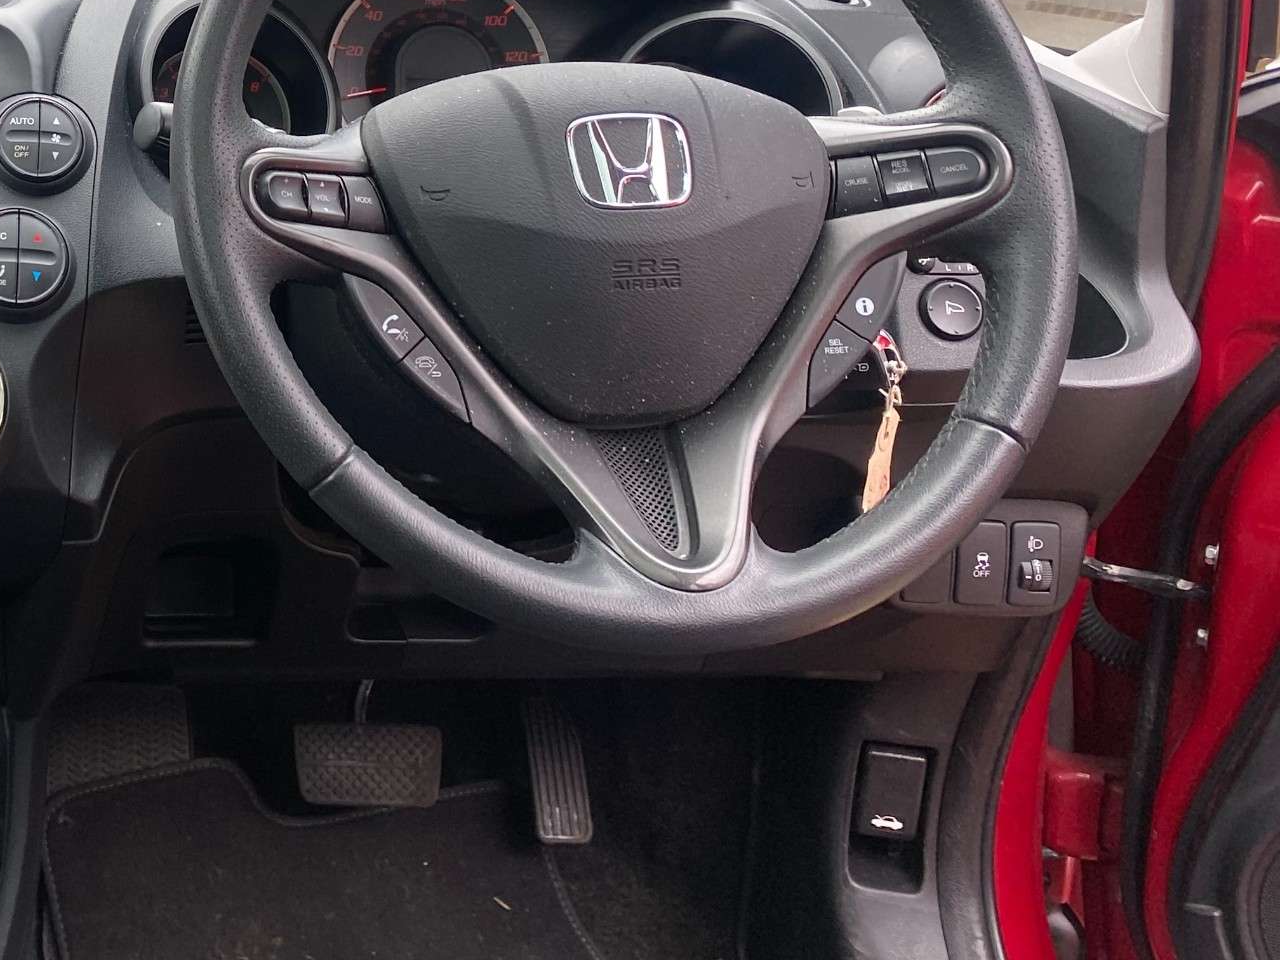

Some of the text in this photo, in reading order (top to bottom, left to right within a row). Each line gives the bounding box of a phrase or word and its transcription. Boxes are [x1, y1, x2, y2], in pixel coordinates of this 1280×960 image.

[366, 10, 384, 22] 40
[484, 15, 508, 27] 100
[346, 46, 364, 57] 20
[504, 51, 528, 63] 120
[10, 117, 35, 126] AUTO
[14, 144, 30, 153] ON/
[891, 160, 908, 169] RES
[940, 164, 968, 174] CANCEL
[354, 195, 373, 204] MODE
[612, 257, 681, 274] SRS
[614, 278, 682, 290] AIRBAG
[824, 346, 849, 354] RESET
[973, 570, 991, 578] OFF
